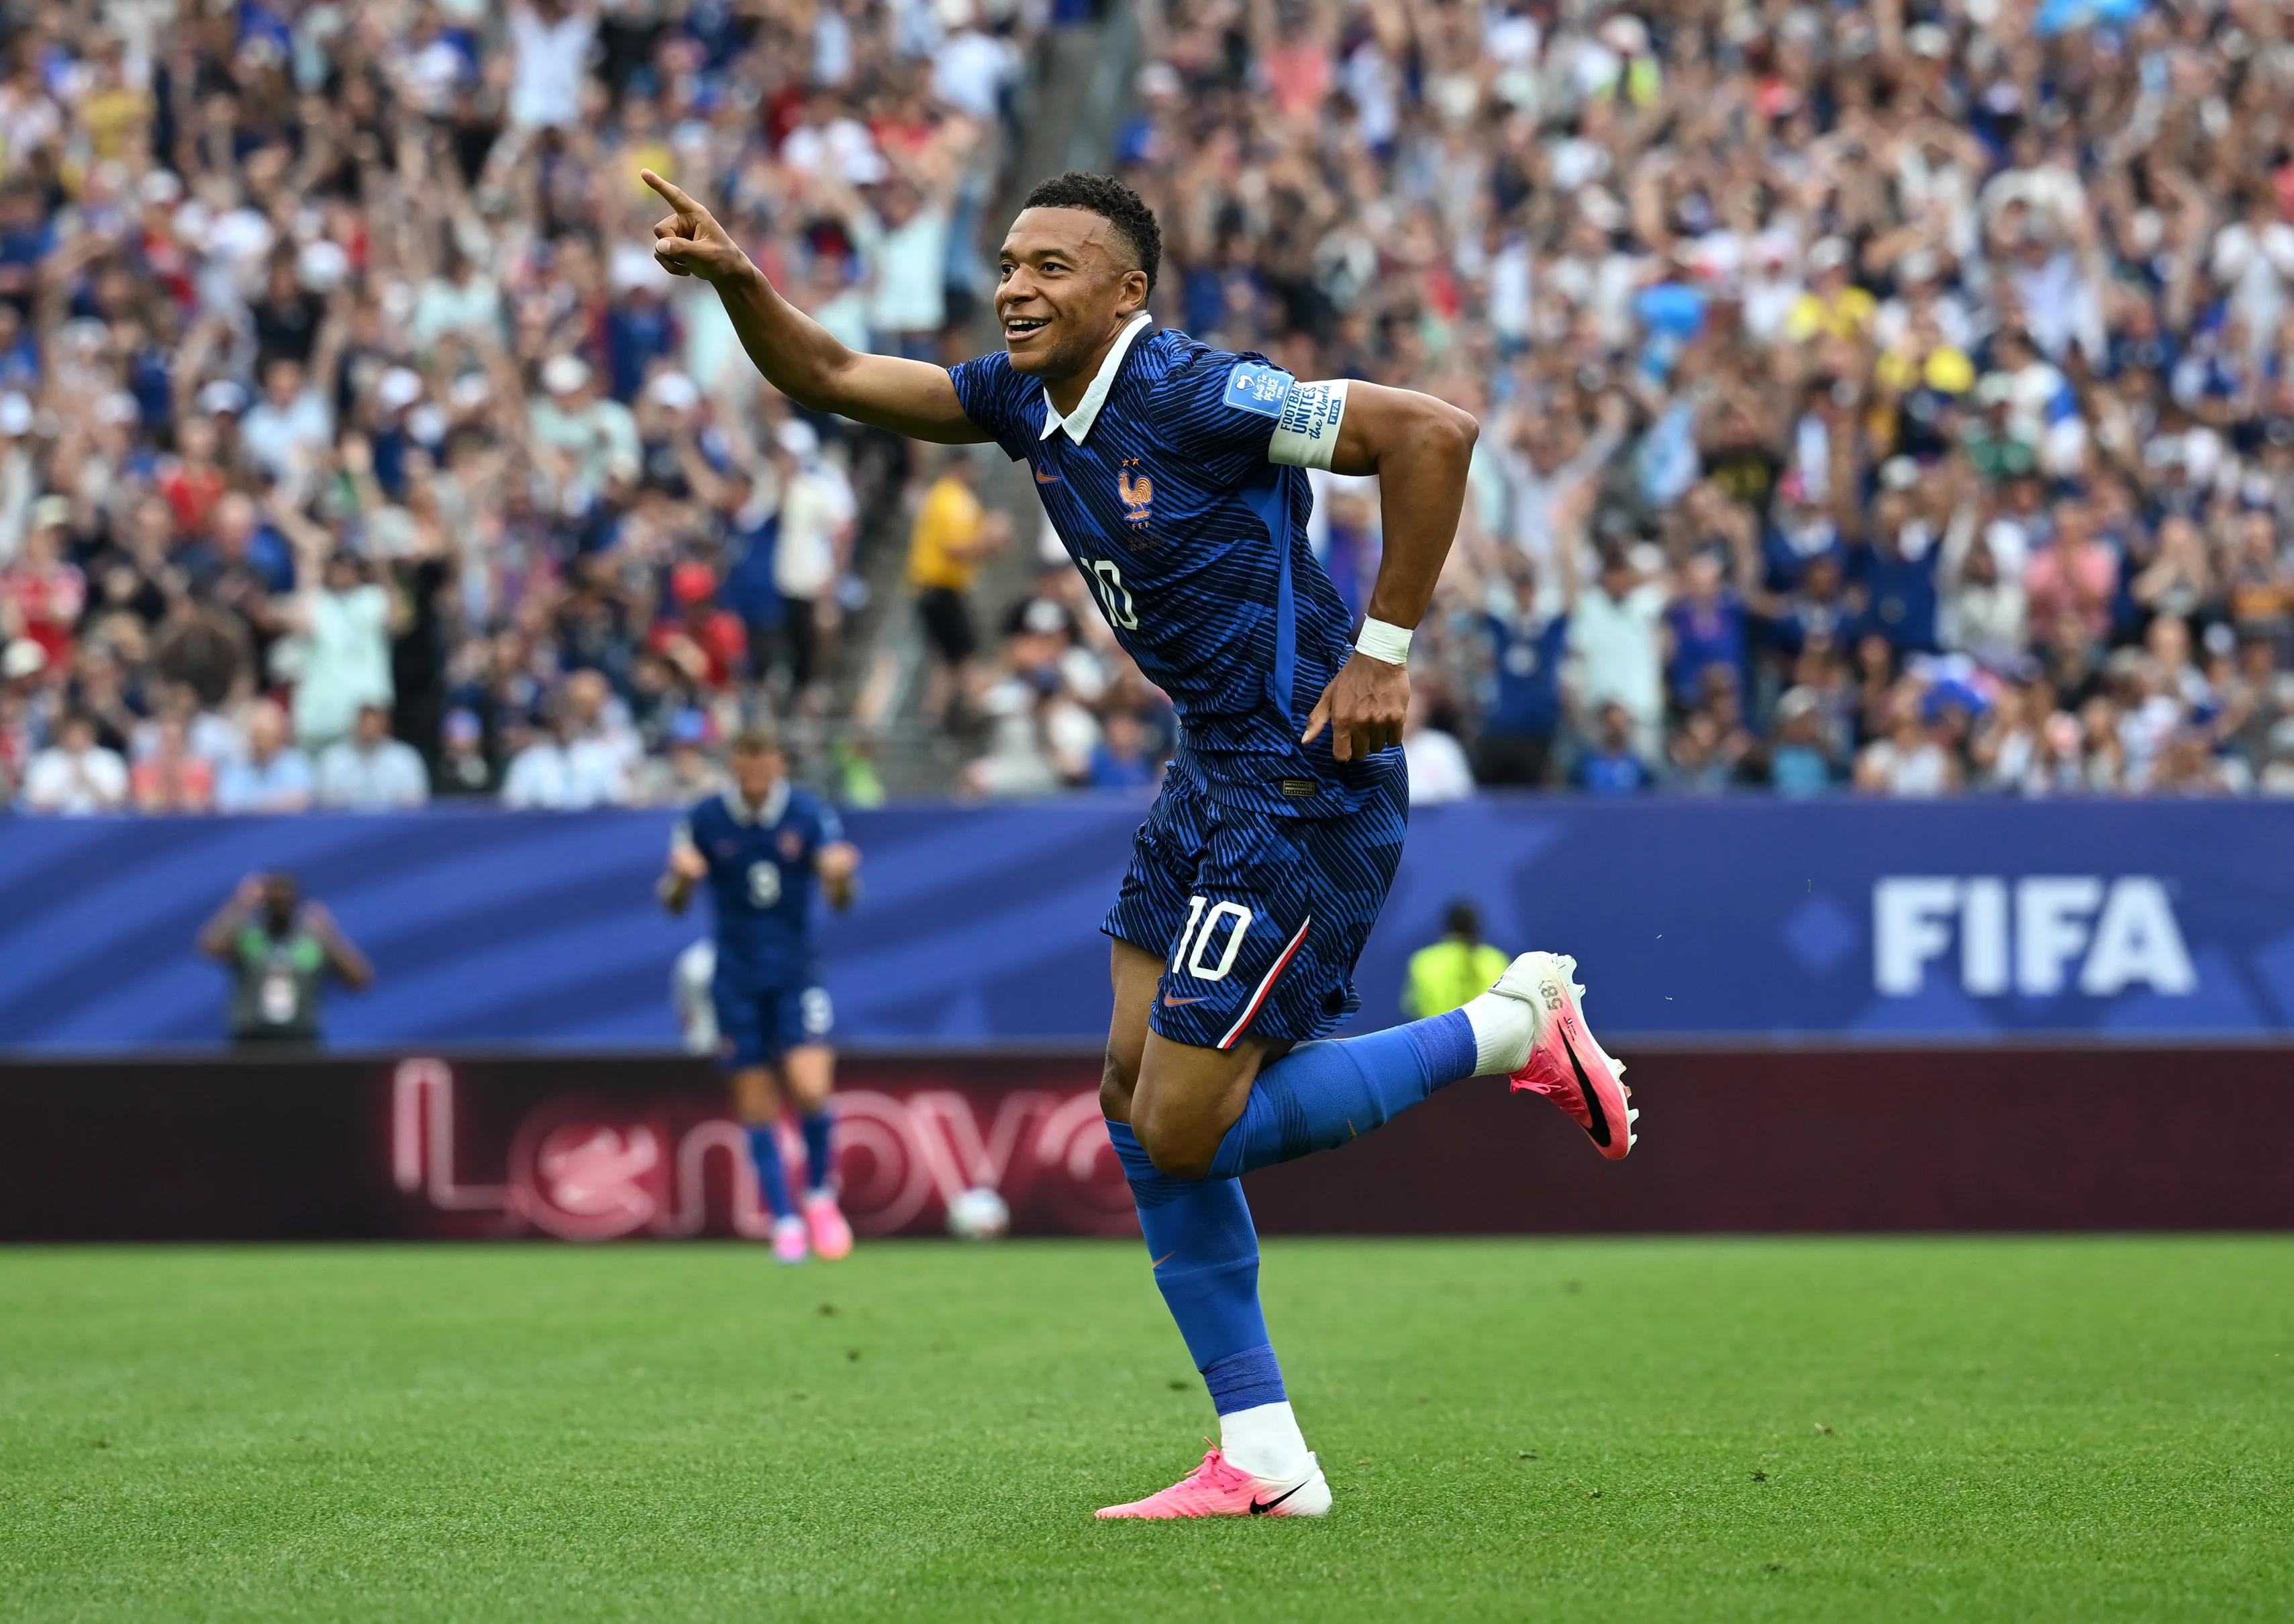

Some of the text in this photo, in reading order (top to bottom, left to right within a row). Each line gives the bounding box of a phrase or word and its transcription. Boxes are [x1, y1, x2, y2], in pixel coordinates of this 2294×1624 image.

[1263, 377, 1279, 402] PEACE
[1276, 385, 1285, 399] FIFA
[1291, 387, 1317, 434] UNITES
[1308, 385, 1332, 440] the World
[1328, 400, 1341, 423] FIFA
[1132, 521, 1150, 531] FFF
[1079, 556, 1138, 630] 10
[1172, 895, 1252, 981] 10
[1875, 875, 2196, 997] FIFA
